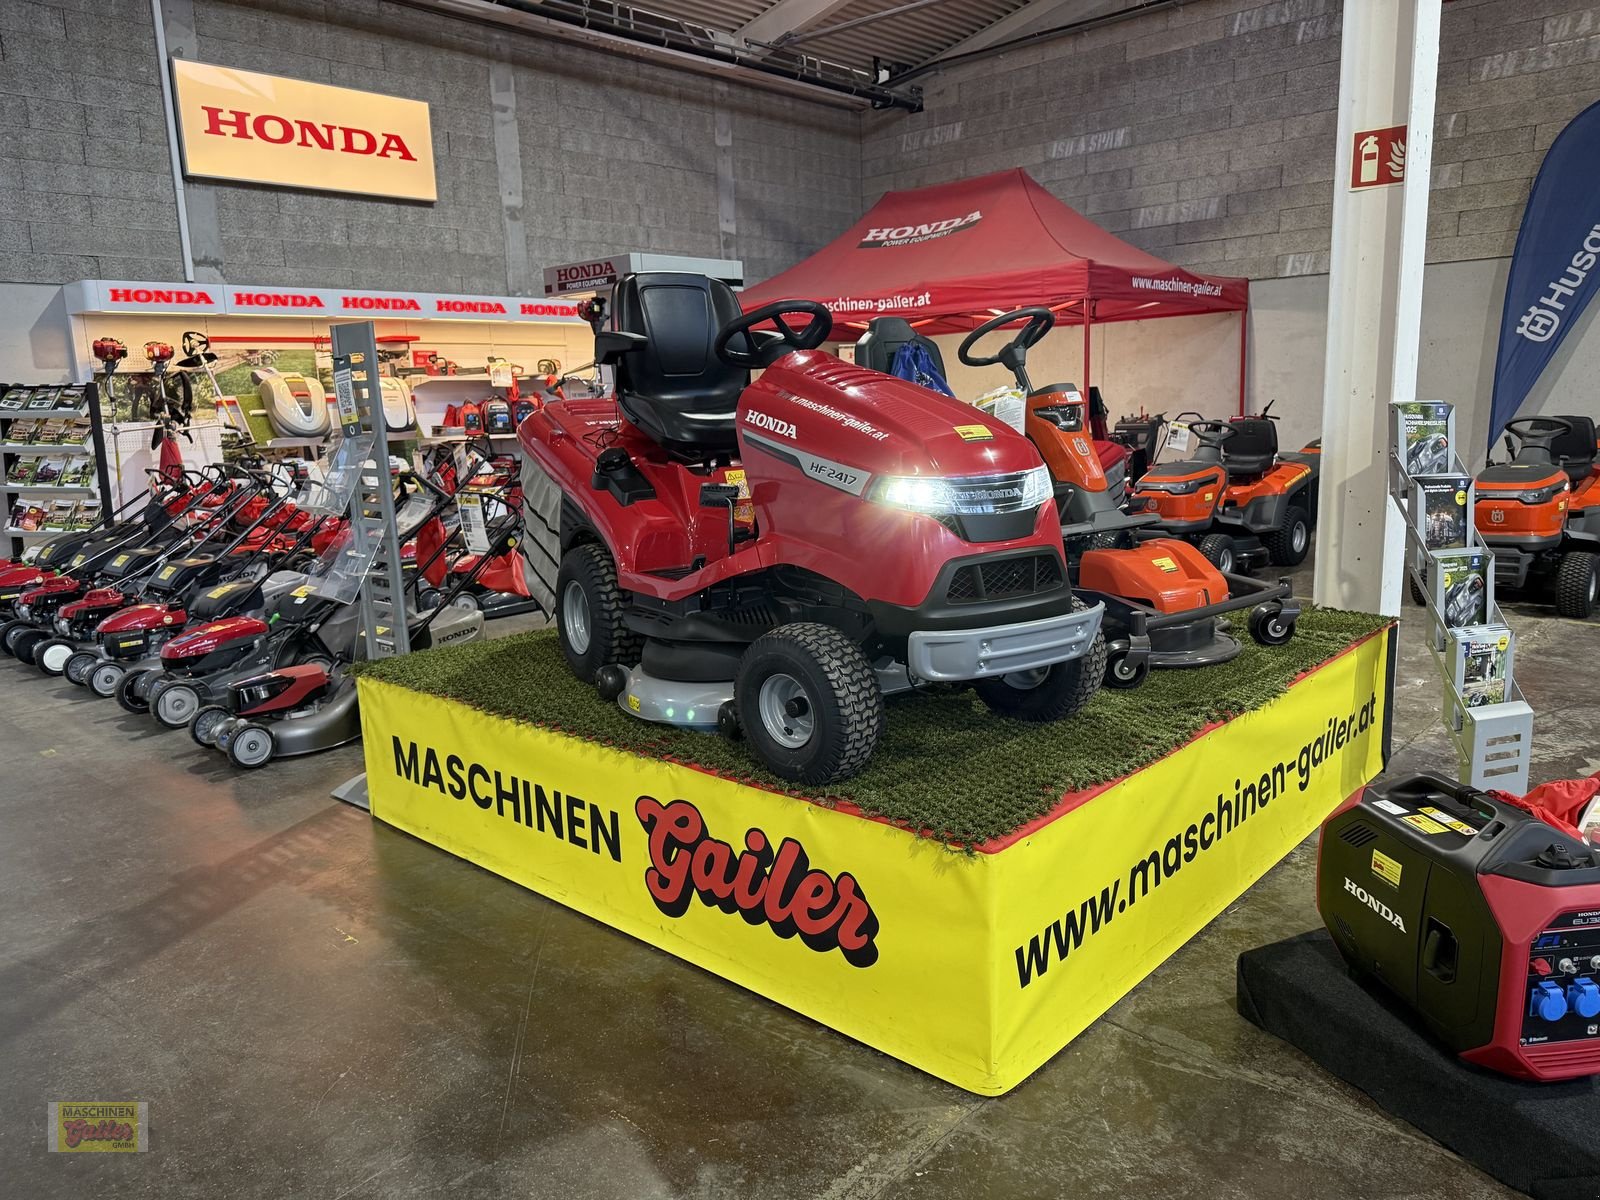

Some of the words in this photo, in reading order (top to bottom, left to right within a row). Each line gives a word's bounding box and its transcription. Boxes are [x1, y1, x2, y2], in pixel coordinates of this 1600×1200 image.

[201, 105, 418, 162] HONDA
[862, 210, 983, 241] HONDA
[881, 238, 909, 248] POWER
[909, 229, 953, 244] EQUIPMENT
[556, 261, 617, 281] HONDA
[566, 281, 582, 289] POWER
[582, 277, 608, 287] EQUIPMENT
[1132, 276, 1223, 297] www.maschinen-gailer.at
[109, 288, 214, 304] HONDA
[234, 292, 325, 307] HONDA
[342, 296, 421, 311] HONDA
[436, 300, 506, 314] HONDA
[745, 409, 797, 440] HONDA
[776, 389, 889, 441] www.maschinen-gailer.at
[810, 461, 827, 475] HF
[827, 468, 858, 486] 2417
[438, 626, 478, 644] HONDA
[1015, 692, 1377, 989] www.maschinen-gailer.at
[392, 735, 622, 863] MASCHINEN
[635, 795, 880, 968] Gailer
[1343, 877, 1406, 934] HONDA
